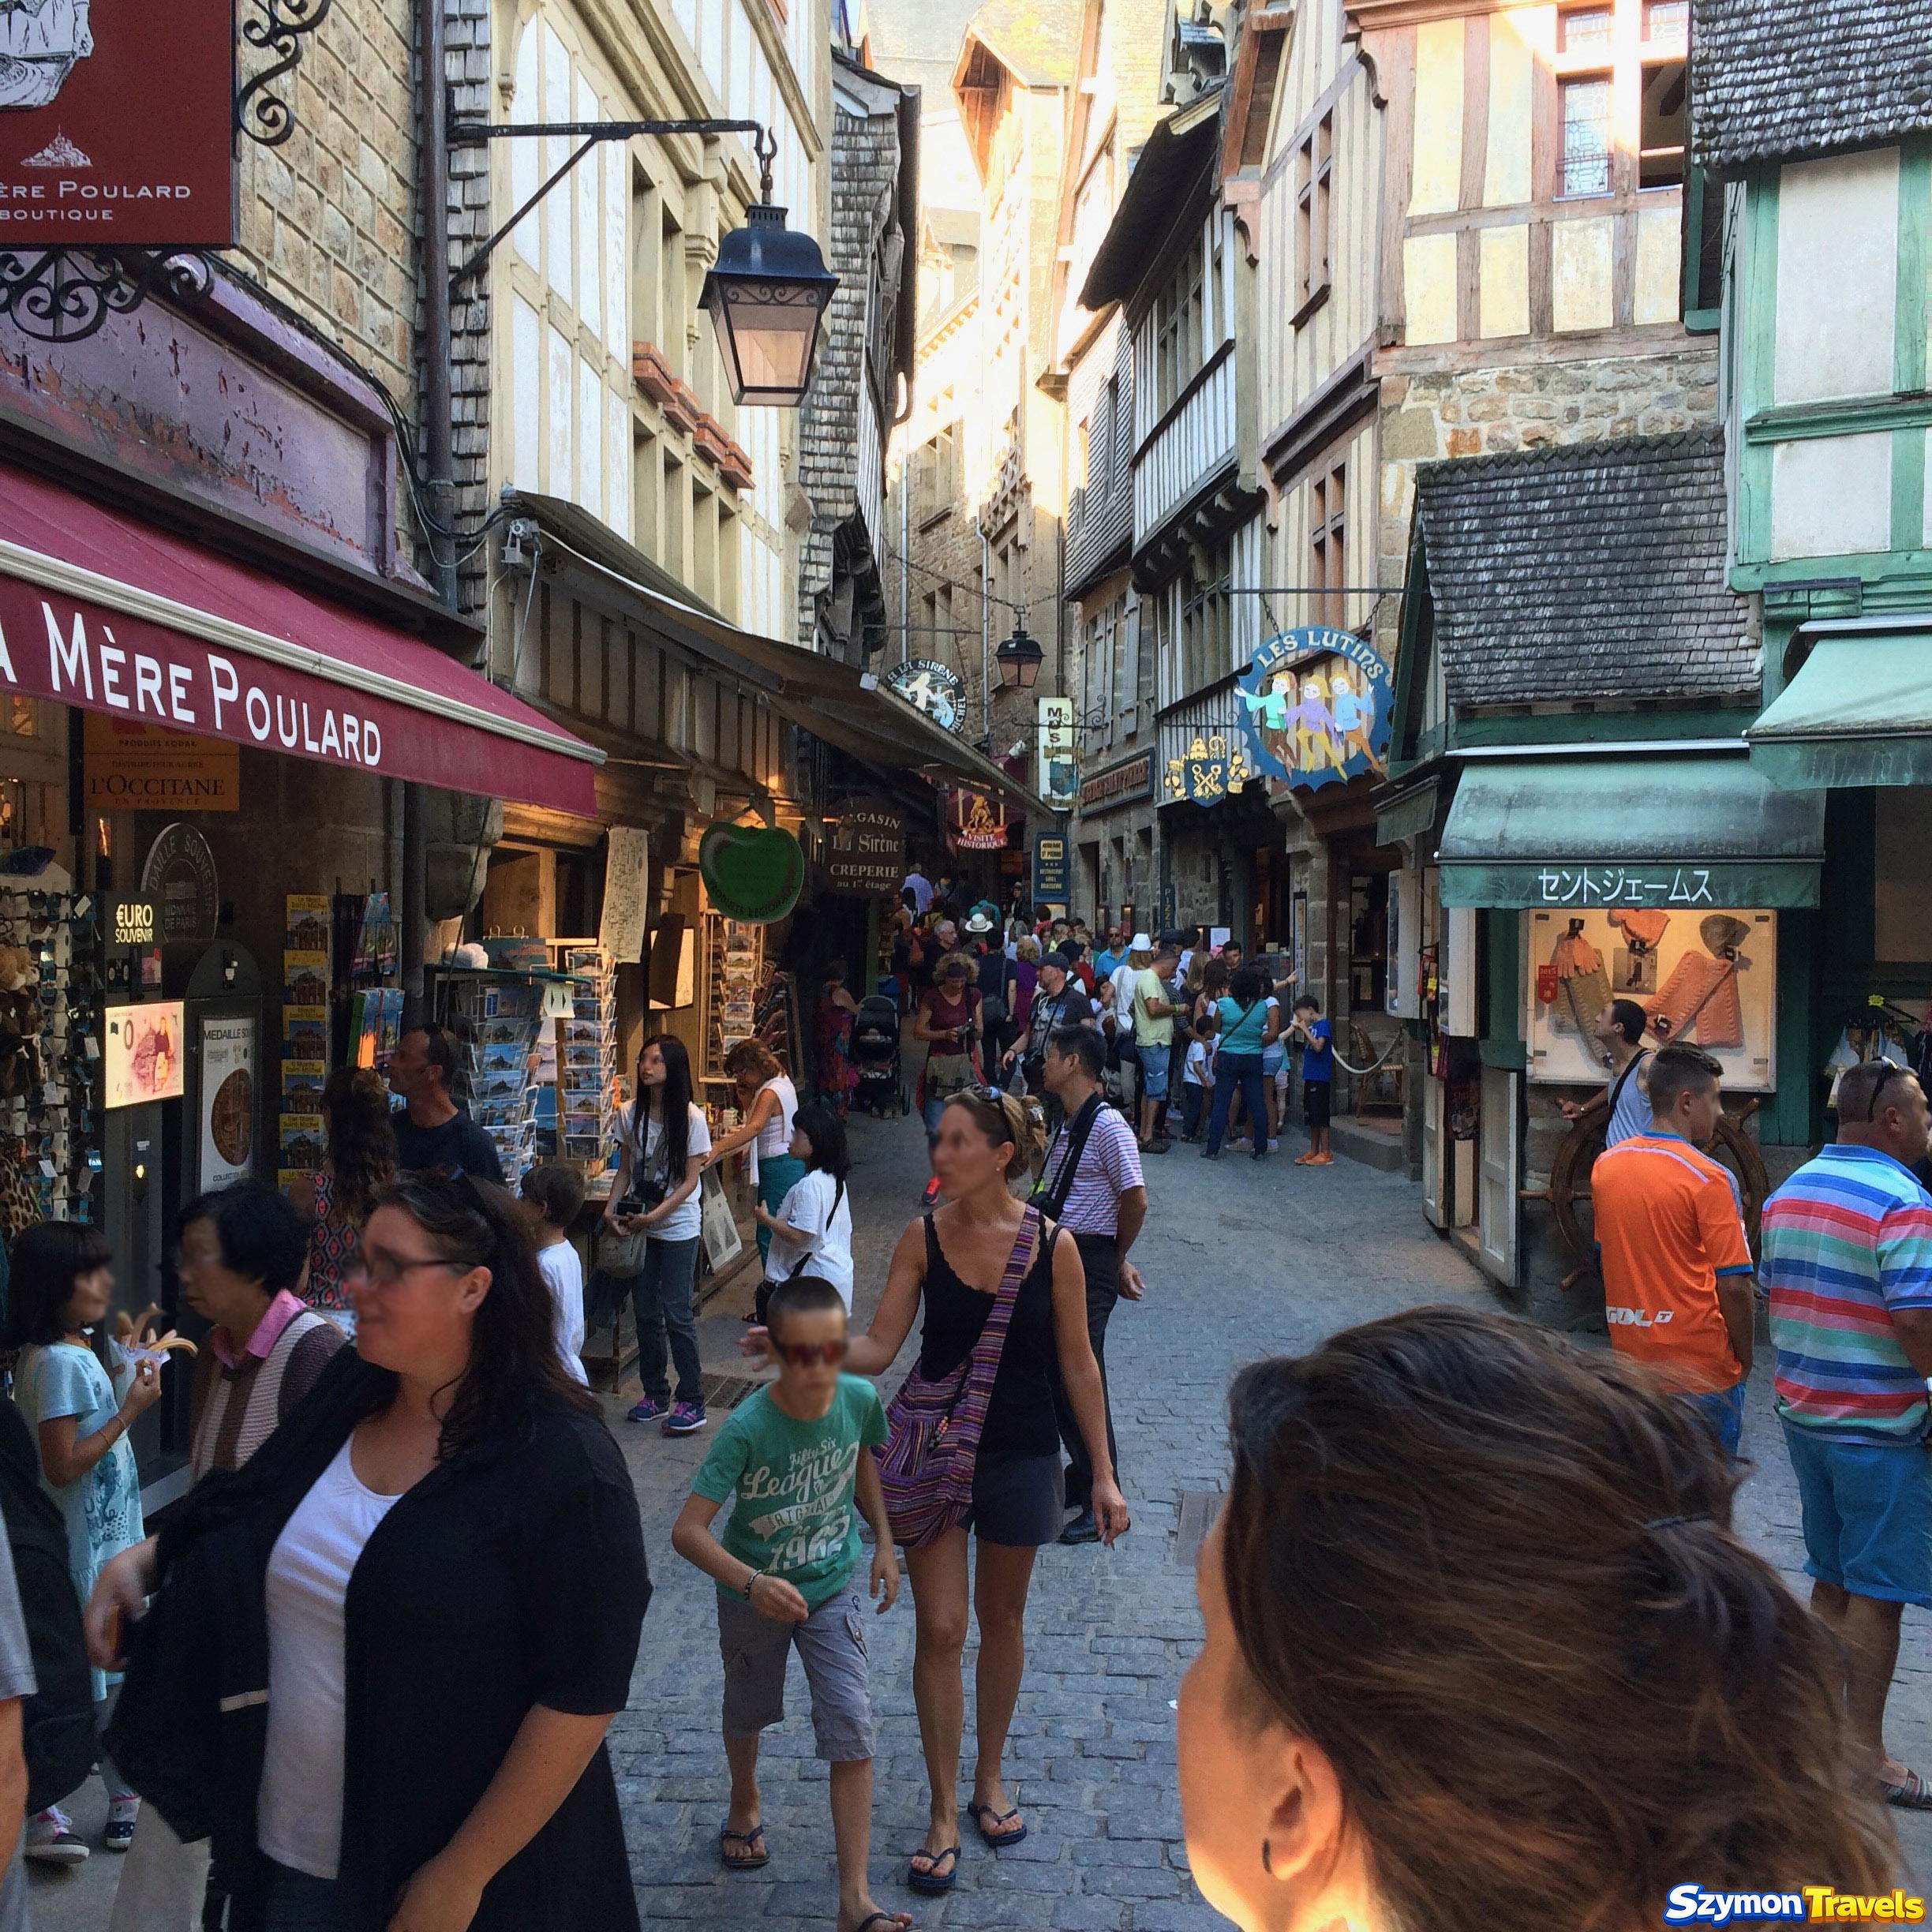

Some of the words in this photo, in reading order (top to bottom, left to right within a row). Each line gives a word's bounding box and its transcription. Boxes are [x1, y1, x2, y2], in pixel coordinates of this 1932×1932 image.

[0, 181, 45, 199] ÈRE
[1256, 635, 1298, 668] LES
[1307, 630, 1384, 680] LUTINS
[41, 601, 195, 723] MÈRE
[207, 653, 382, 766] POULARD
[1537, 867, 1713, 902] セントジェームス
[115, 928, 153, 943] SOUVENIR
[740, 1448, 844, 1503] League
